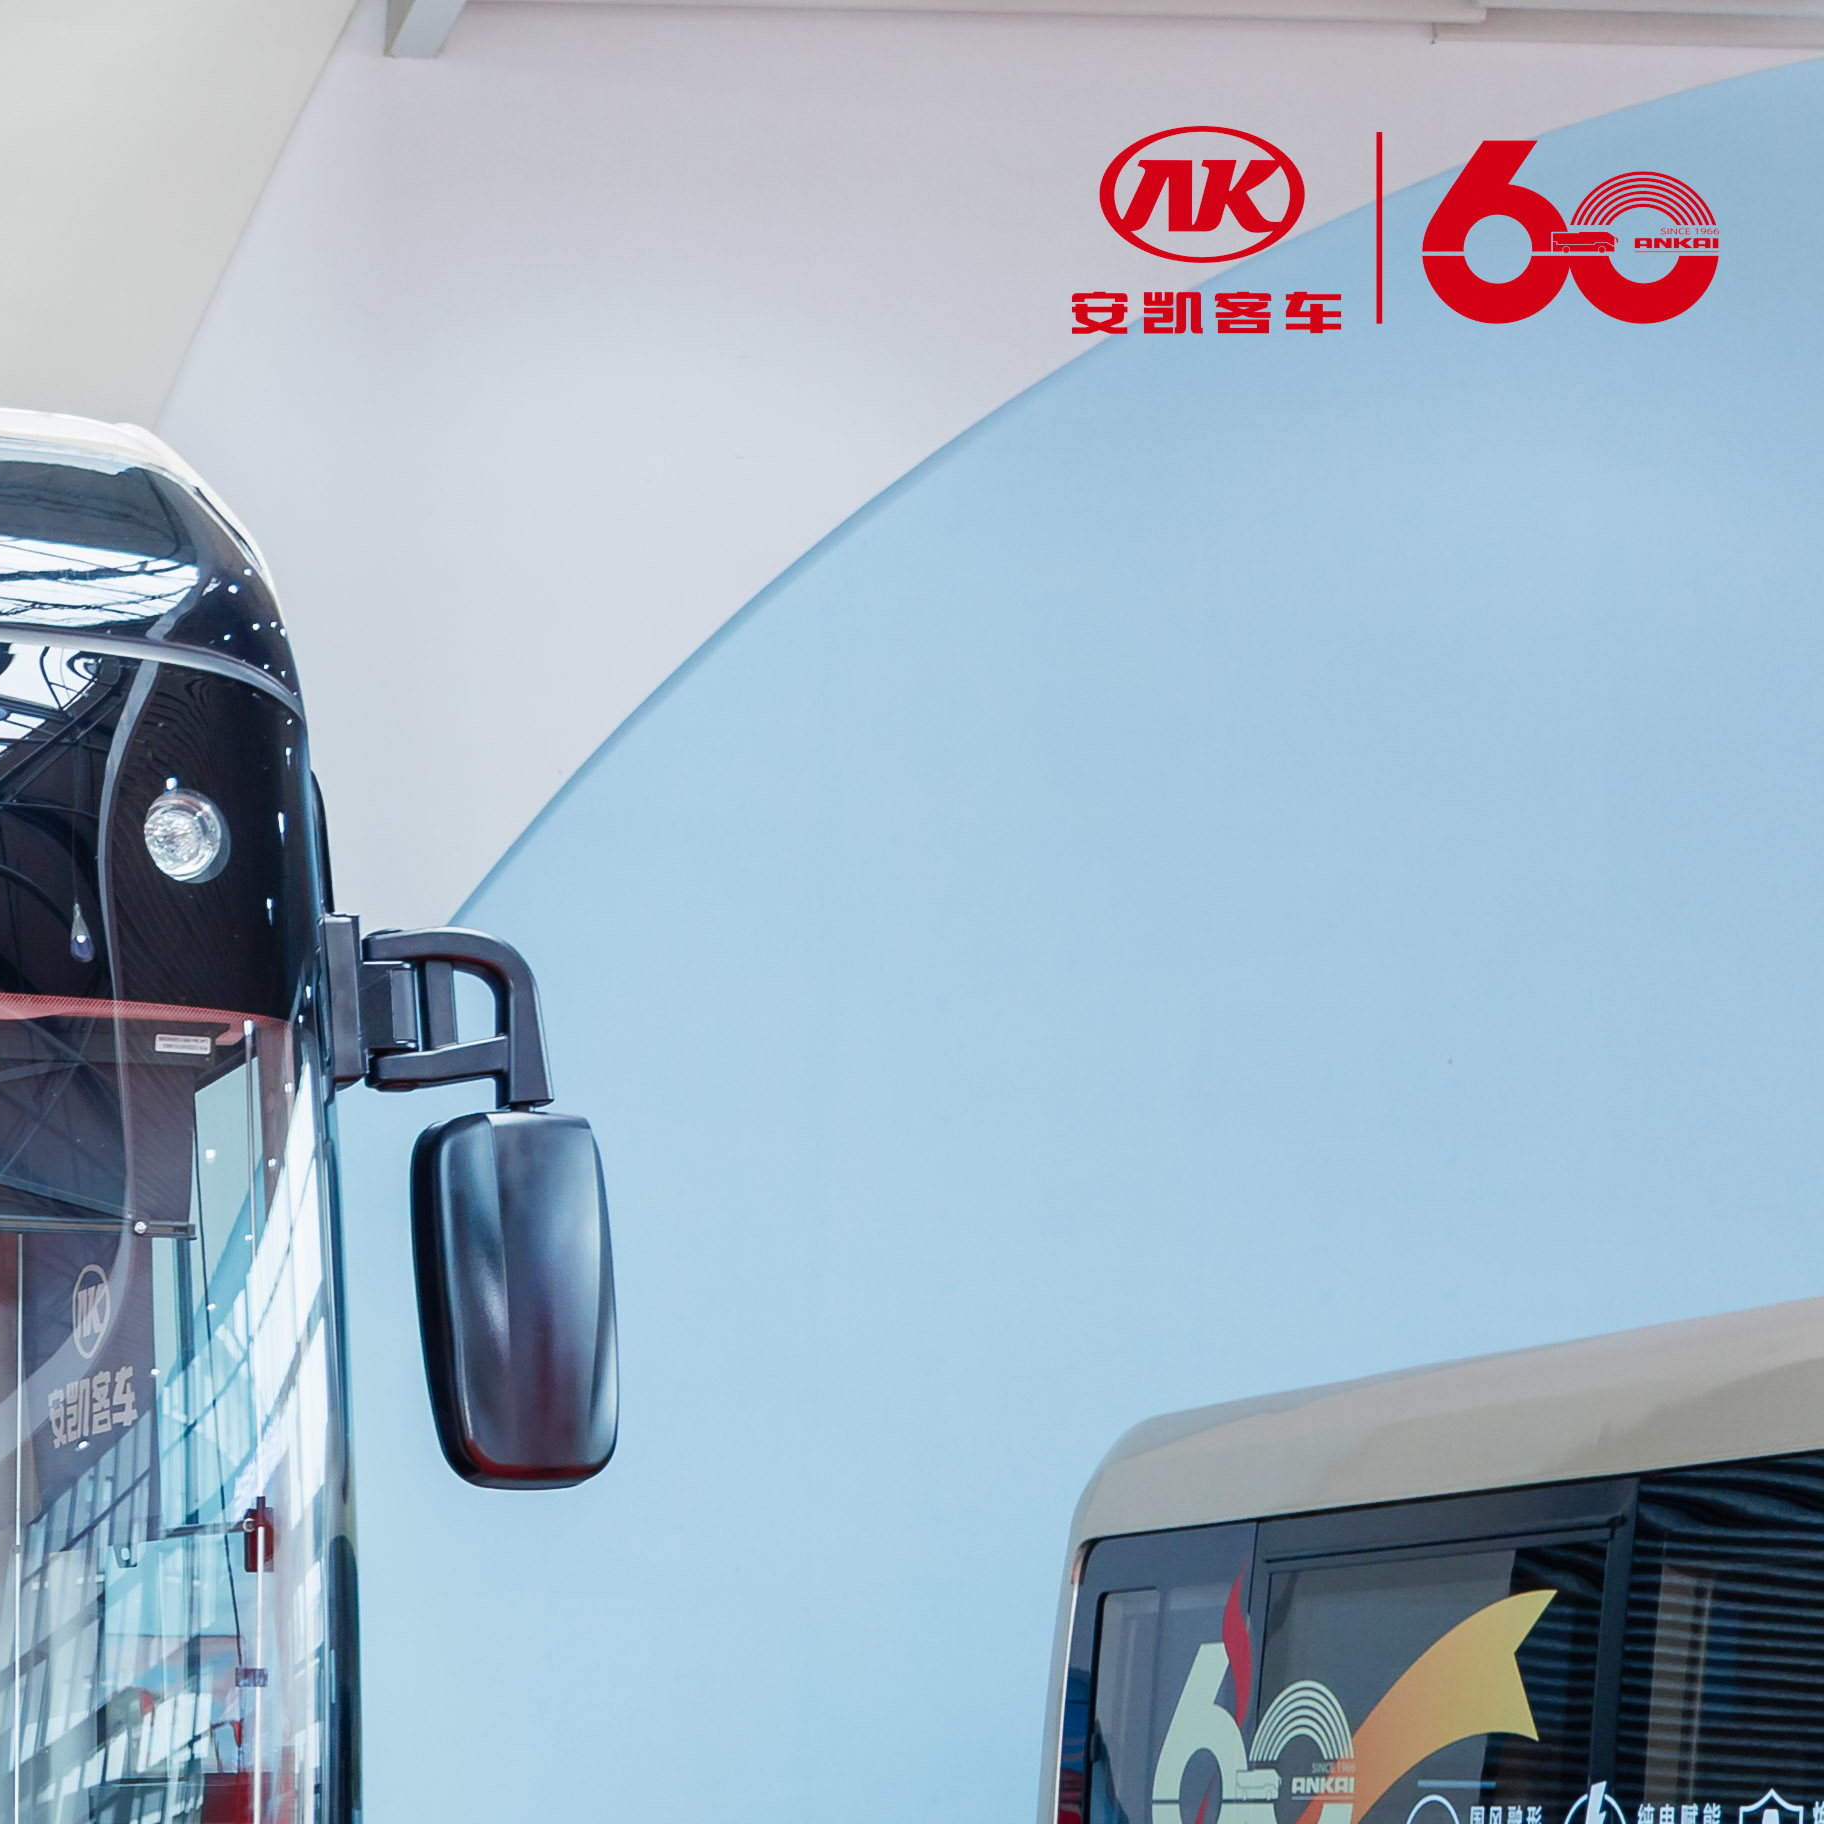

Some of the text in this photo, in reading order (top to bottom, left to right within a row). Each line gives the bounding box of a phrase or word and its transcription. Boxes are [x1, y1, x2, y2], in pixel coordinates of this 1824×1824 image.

[48, 1366, 138, 1449] 安凯客车
[1292, 1776, 1355, 1794] ANKAI
